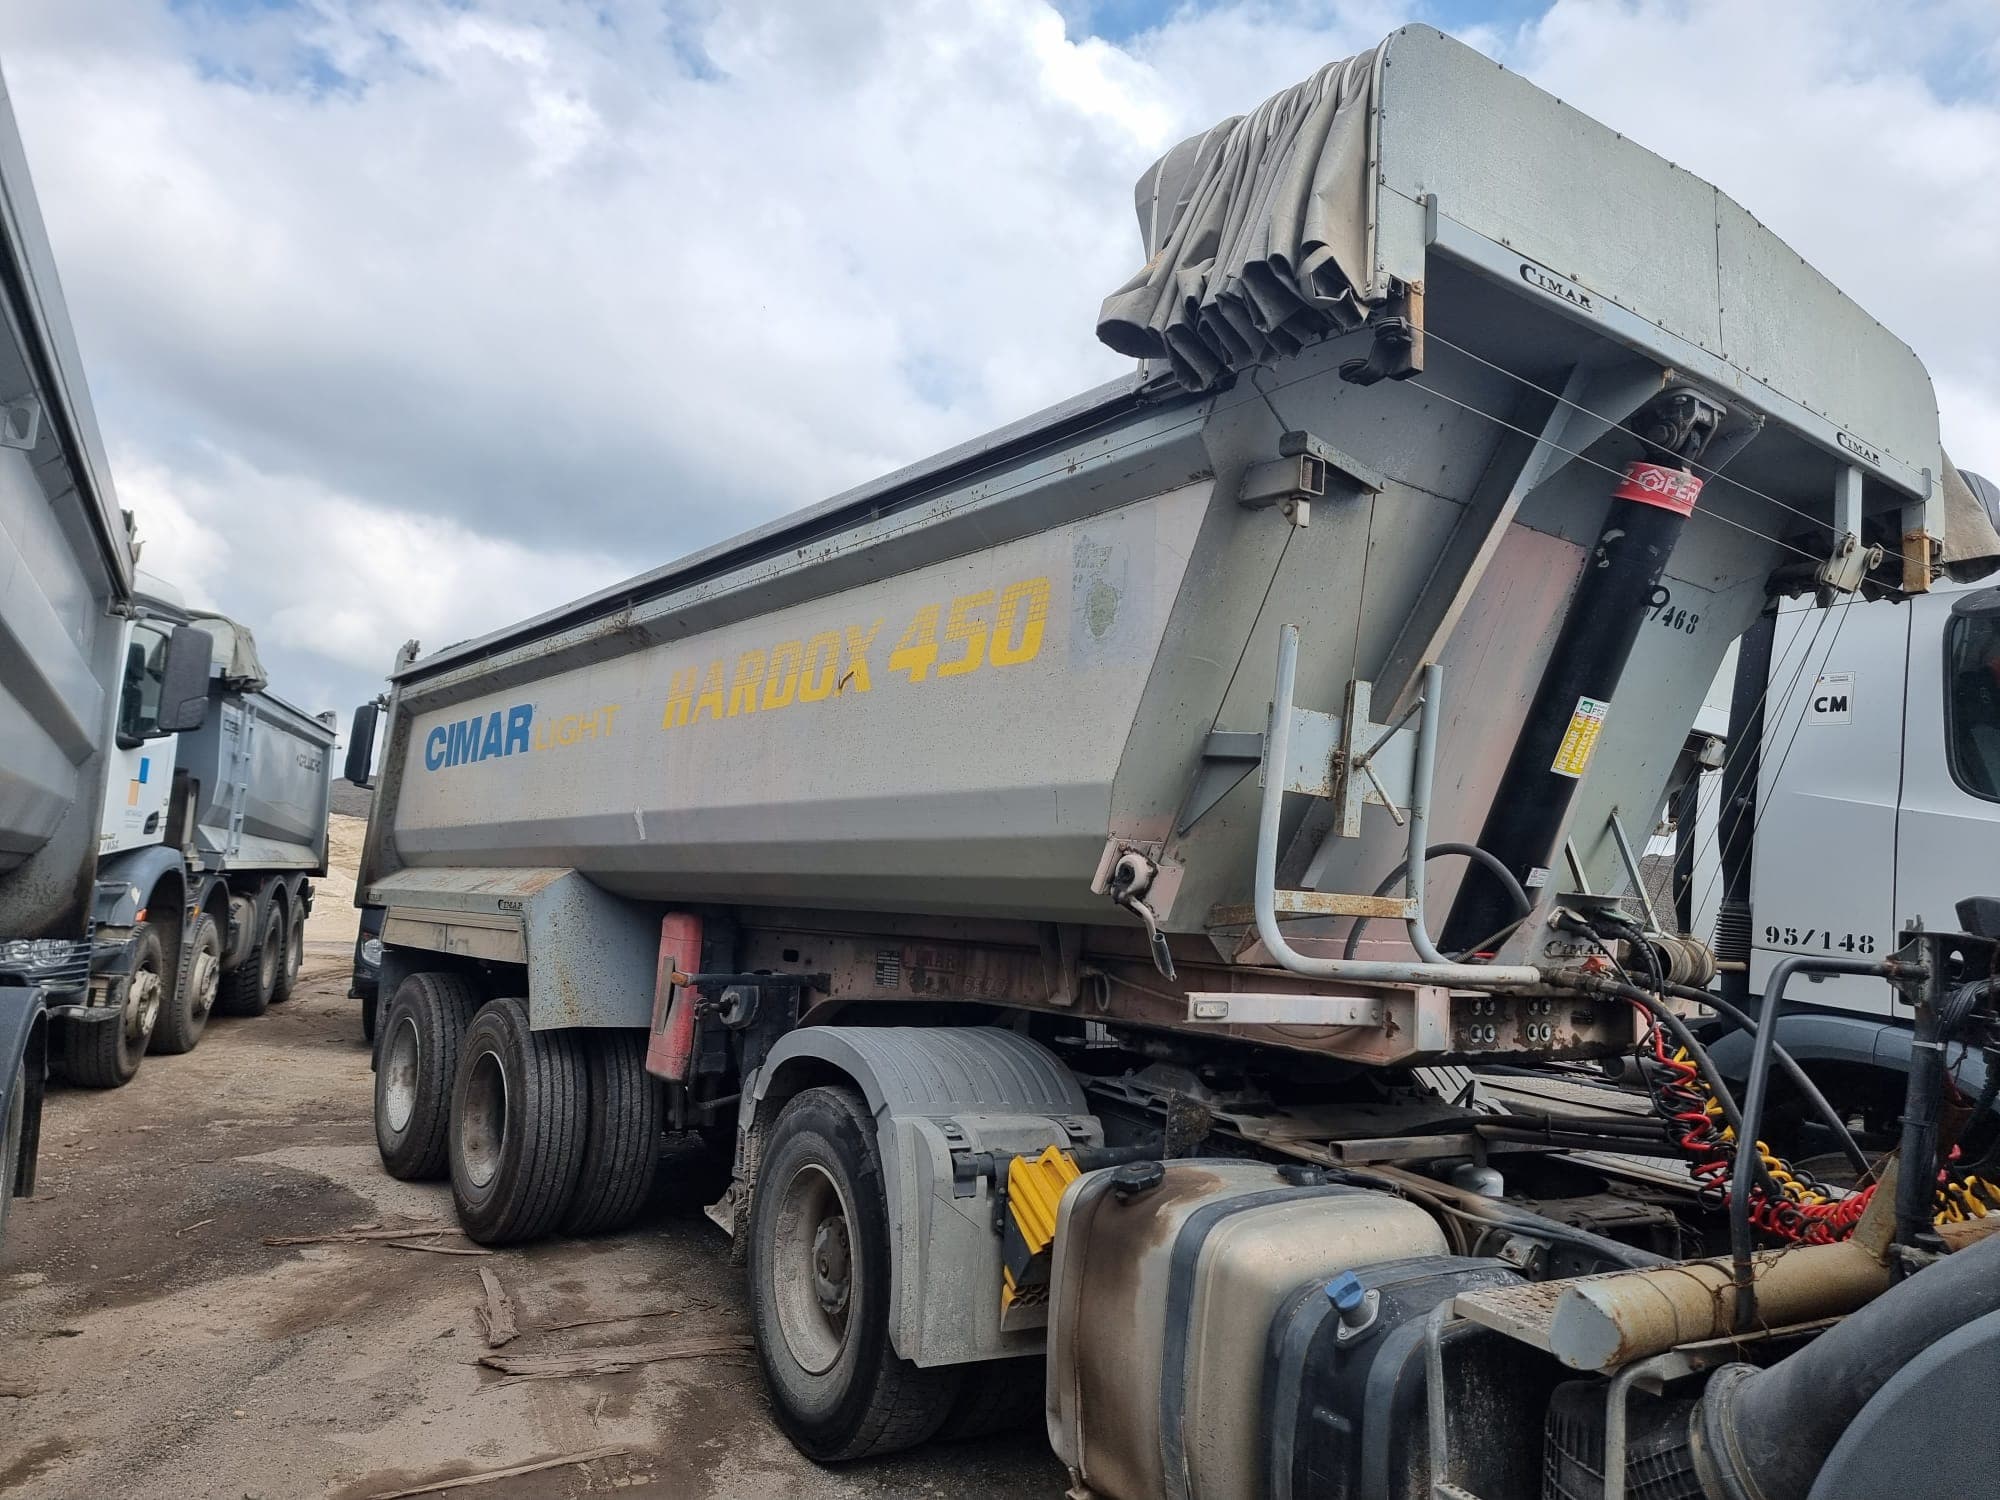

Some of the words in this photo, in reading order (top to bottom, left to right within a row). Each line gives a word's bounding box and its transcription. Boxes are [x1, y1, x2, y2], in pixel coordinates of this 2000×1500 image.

[1519, 263, 1593, 313] CIMAR
[1836, 431, 1881, 468] CIMAR
[662, 617, 886, 731] HARDOX
[888, 575, 1051, 684] 450
[1814, 695, 1848, 713] CM
[425, 703, 533, 772] CIMAR
[534, 704, 622, 751] LIGHT
[1765, 926, 1875, 954] 95/148
